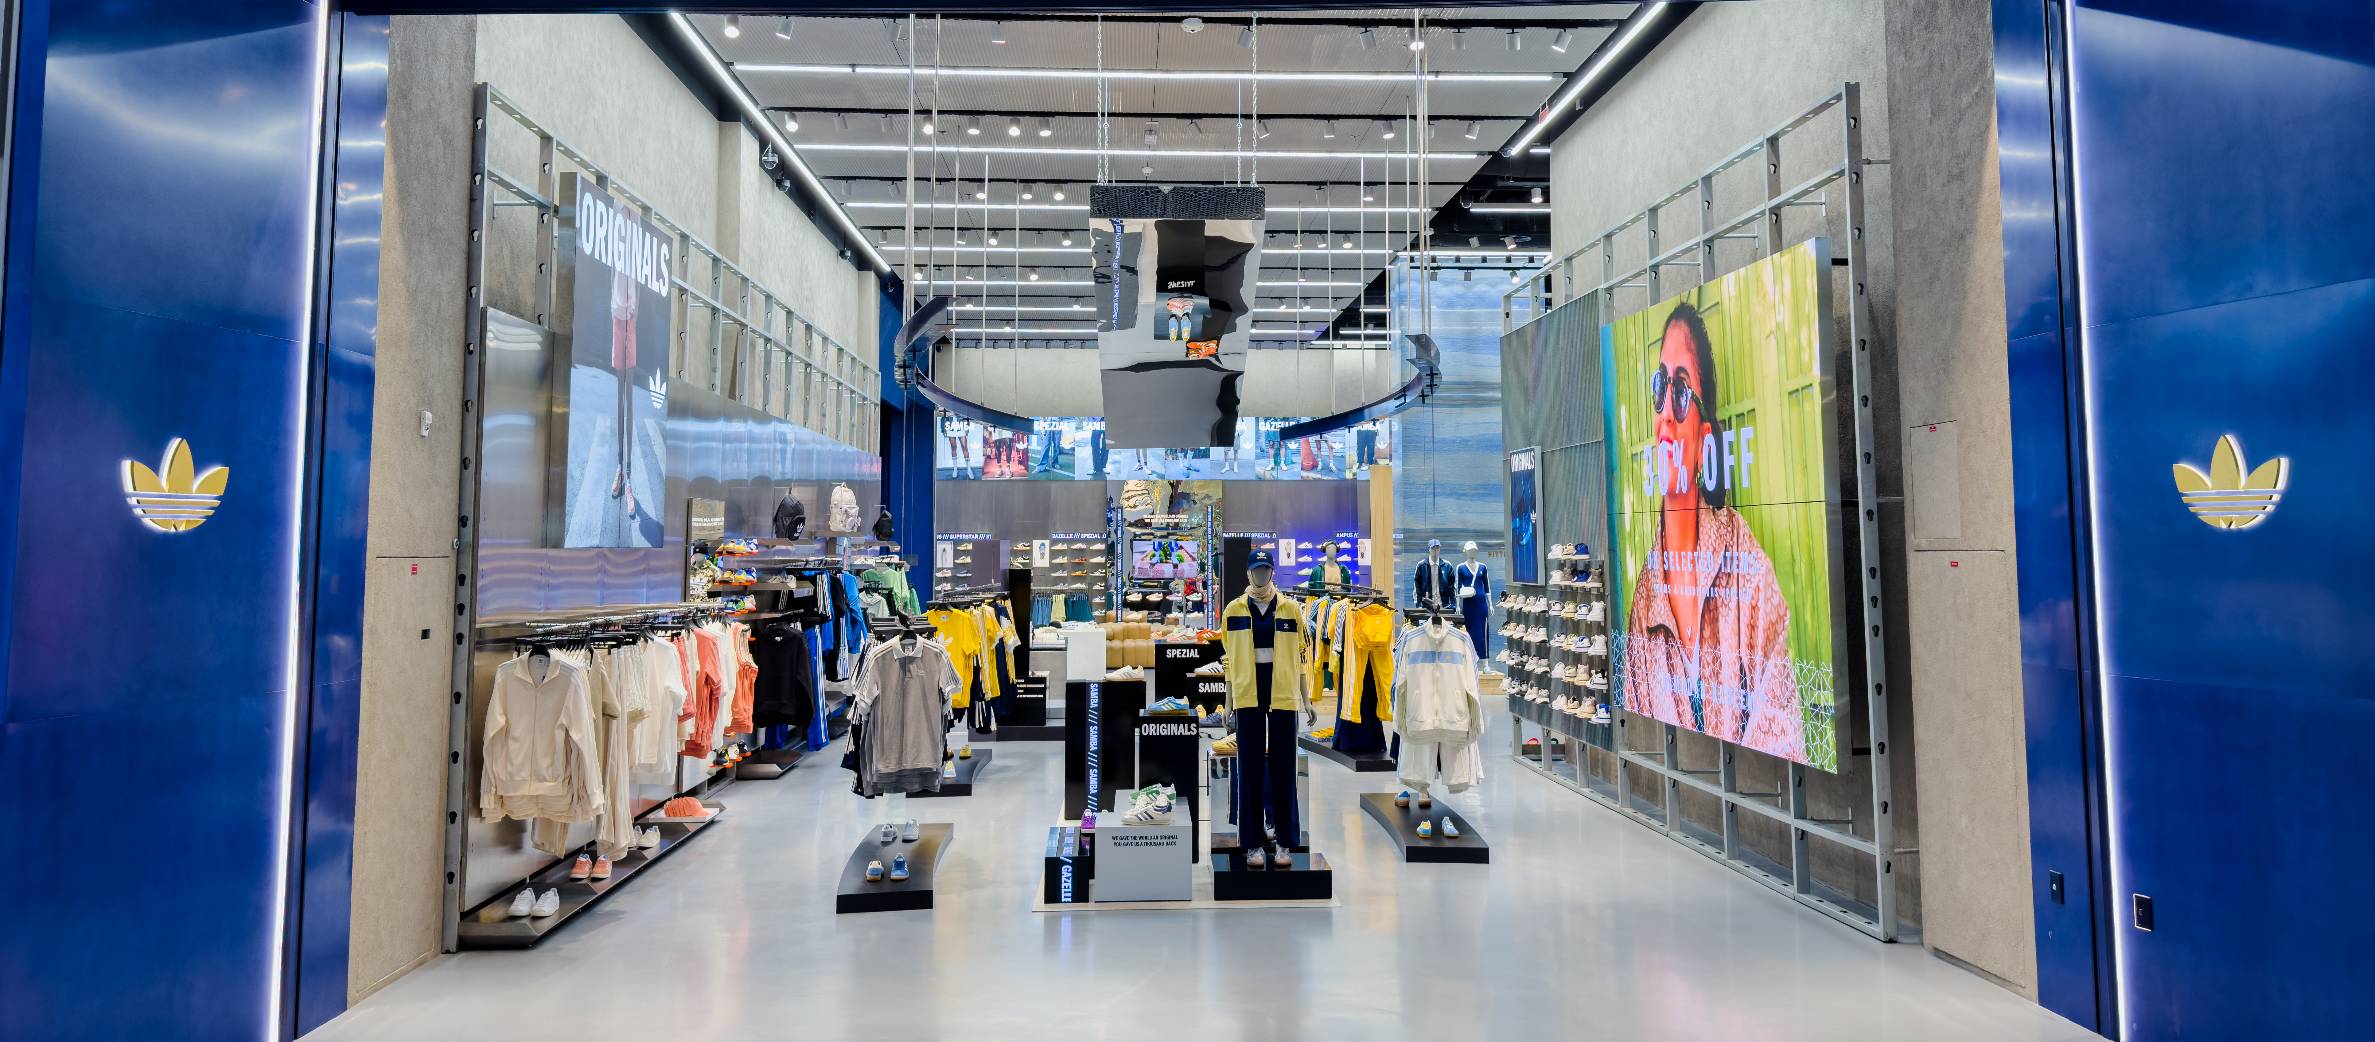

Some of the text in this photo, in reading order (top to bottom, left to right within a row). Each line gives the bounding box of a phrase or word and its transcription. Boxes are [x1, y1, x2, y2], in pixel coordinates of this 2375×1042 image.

[581, 192, 670, 297] ORIGINALS
[1082, 421, 1105, 431] SAMB
[1643, 426, 1754, 497] 30% OFF
[1647, 550, 1759, 575] ON SELECTED ITEMS
[1166, 648, 1200, 658] SPEZIAL
[1089, 683, 1099, 708] SAMBA
[1089, 725, 1098, 751] SAMBA
[1141, 723, 1197, 735] ORIGINALS
[1089, 768, 1098, 794] SAMBA
[1061, 865, 1073, 902] GAZELLE
